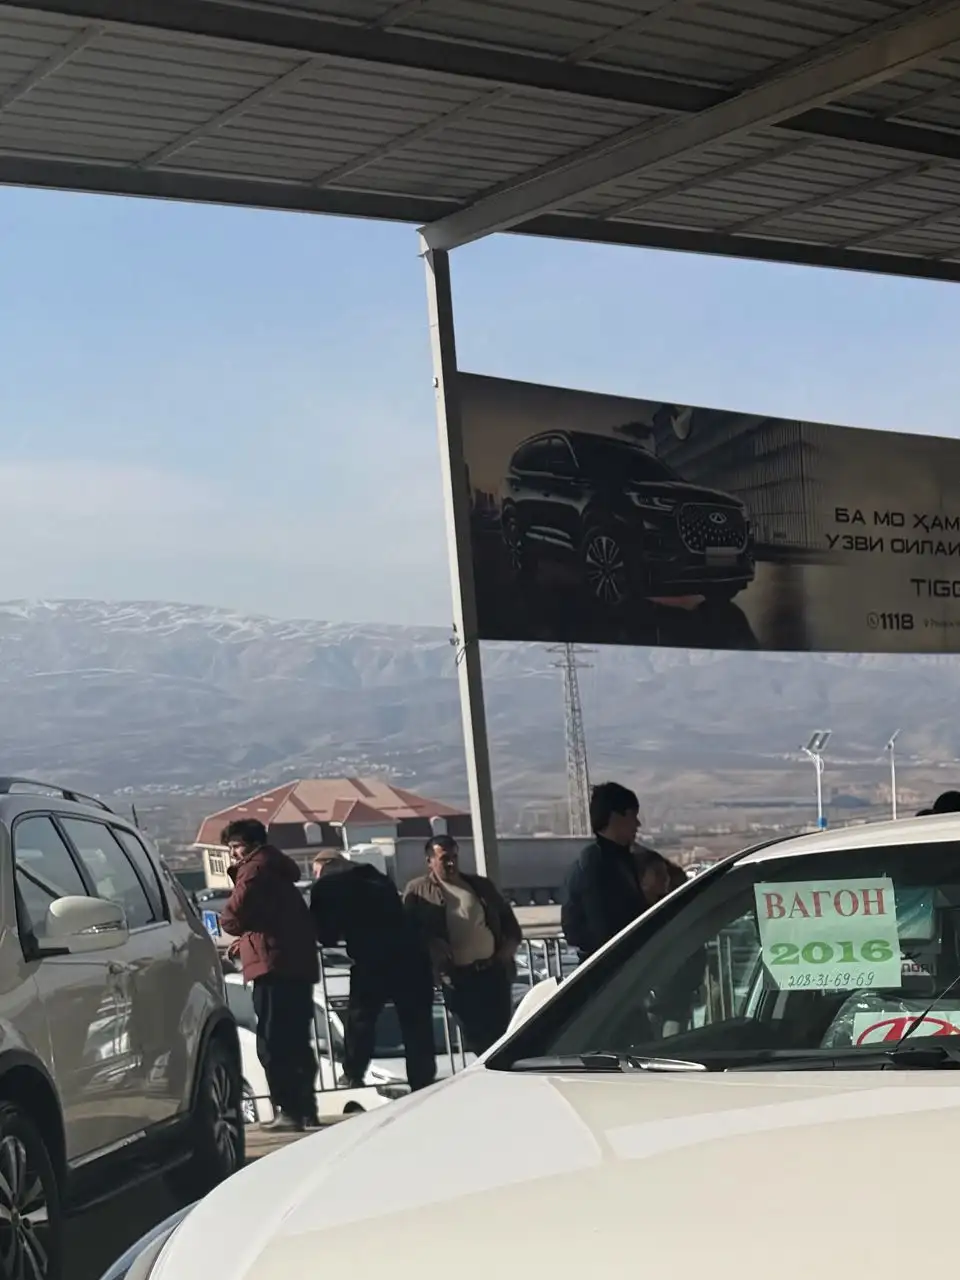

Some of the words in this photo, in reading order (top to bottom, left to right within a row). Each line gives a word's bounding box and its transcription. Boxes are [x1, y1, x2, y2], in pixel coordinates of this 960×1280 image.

[835, 508, 867, 526] БА
[874, 511, 905, 527] МО
[825, 534, 884, 553] УЗВИ
[880, 612, 914, 631] 1118
[762, 887, 888, 919] ВАГОН
[769, 939, 894, 965] 2016
